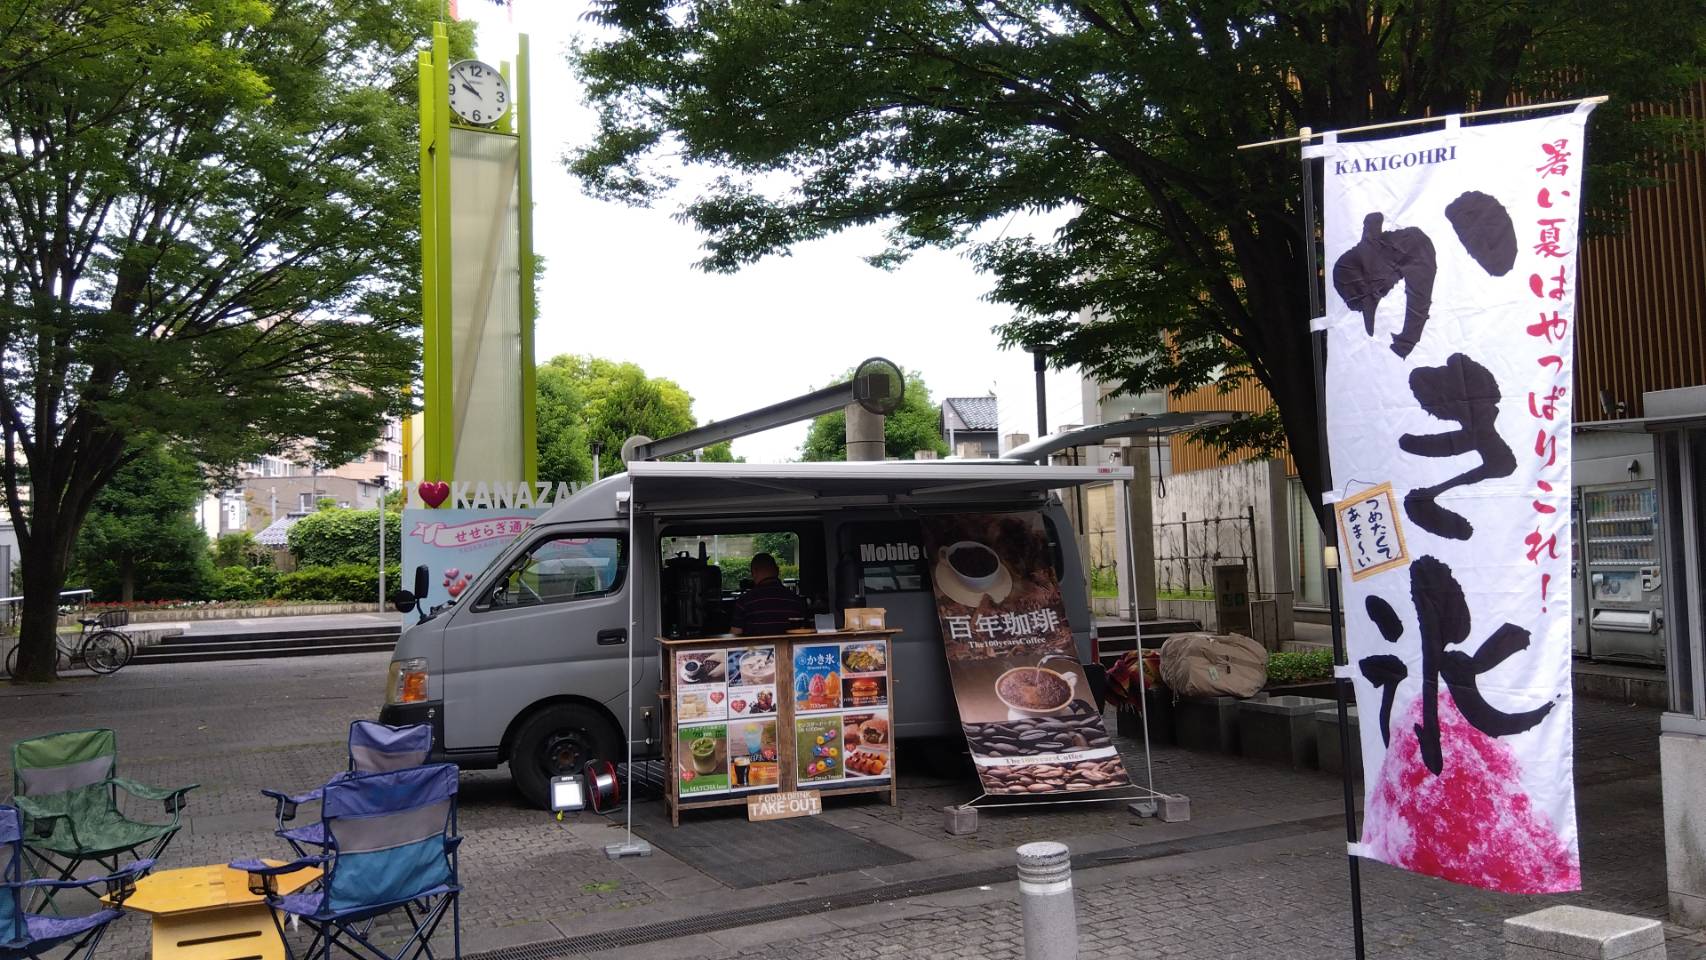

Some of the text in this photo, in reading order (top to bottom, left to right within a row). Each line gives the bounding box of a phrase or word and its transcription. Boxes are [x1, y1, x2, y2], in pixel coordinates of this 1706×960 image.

[469, 65, 482, 78] 12
[448, 84, 456, 96] 9
[496, 91, 505, 103] 3
[472, 109, 481, 122] 6
[1335, 145, 1457, 176] KAKIGOHRI
[1332, 190, 1560, 777] かき氷
[1366, 499, 1392, 560] つめたくて
[860, 542, 920, 562] Mobile
[945, 607, 1060, 640] 百年珈琲
[806, 653, 836, 665] かき氷
